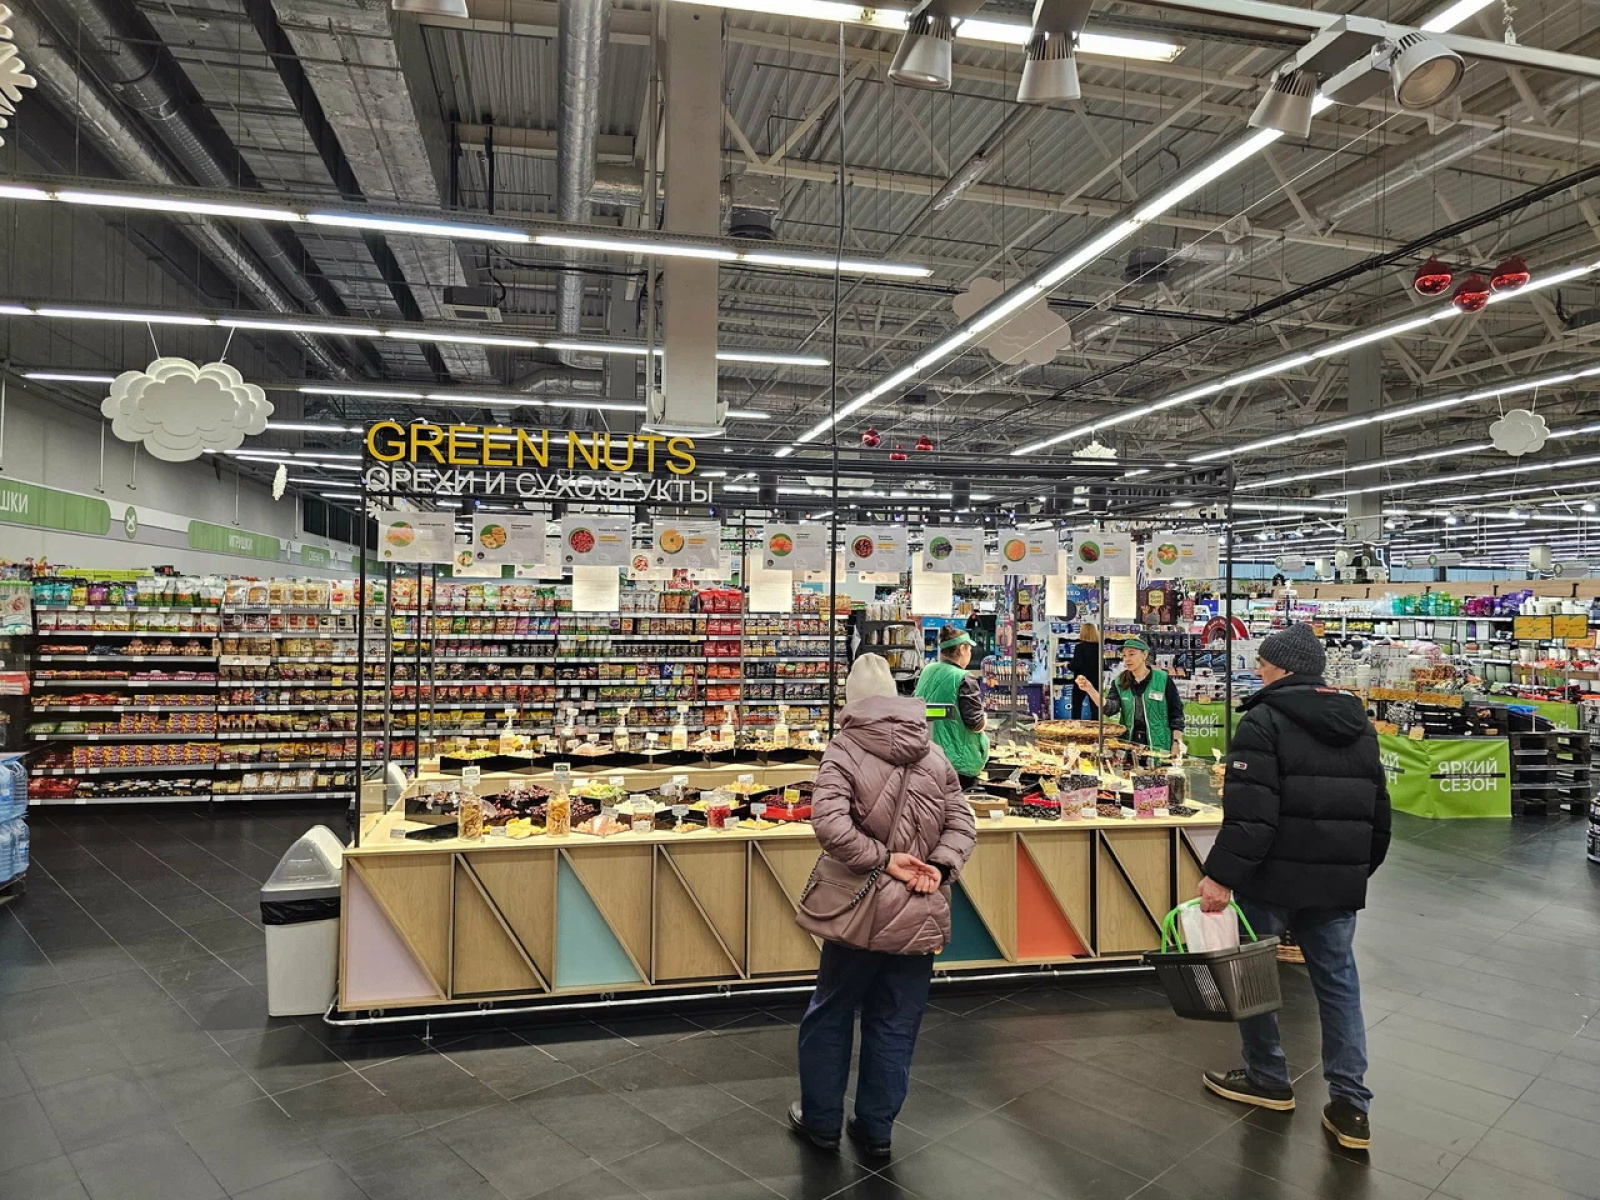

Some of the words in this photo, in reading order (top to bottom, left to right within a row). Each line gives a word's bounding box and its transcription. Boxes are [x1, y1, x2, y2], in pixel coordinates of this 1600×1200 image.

[367, 421, 548, 467] GREEN
[568, 430, 697, 475] NUTS
[364, 467, 475, 496] ОРЕХИ
[485, 471, 506, 496] И
[515, 473, 714, 504] СУХОФРУКТЫ
[0, 490, 29, 515] ШКИ
[1184, 713, 1219, 725] РКИЙ
[1184, 727, 1219, 738] ЕЗОН
[1438, 757, 1498, 775] ЯРКИЙ
[1439, 778, 1498, 792] СЕЗОН
